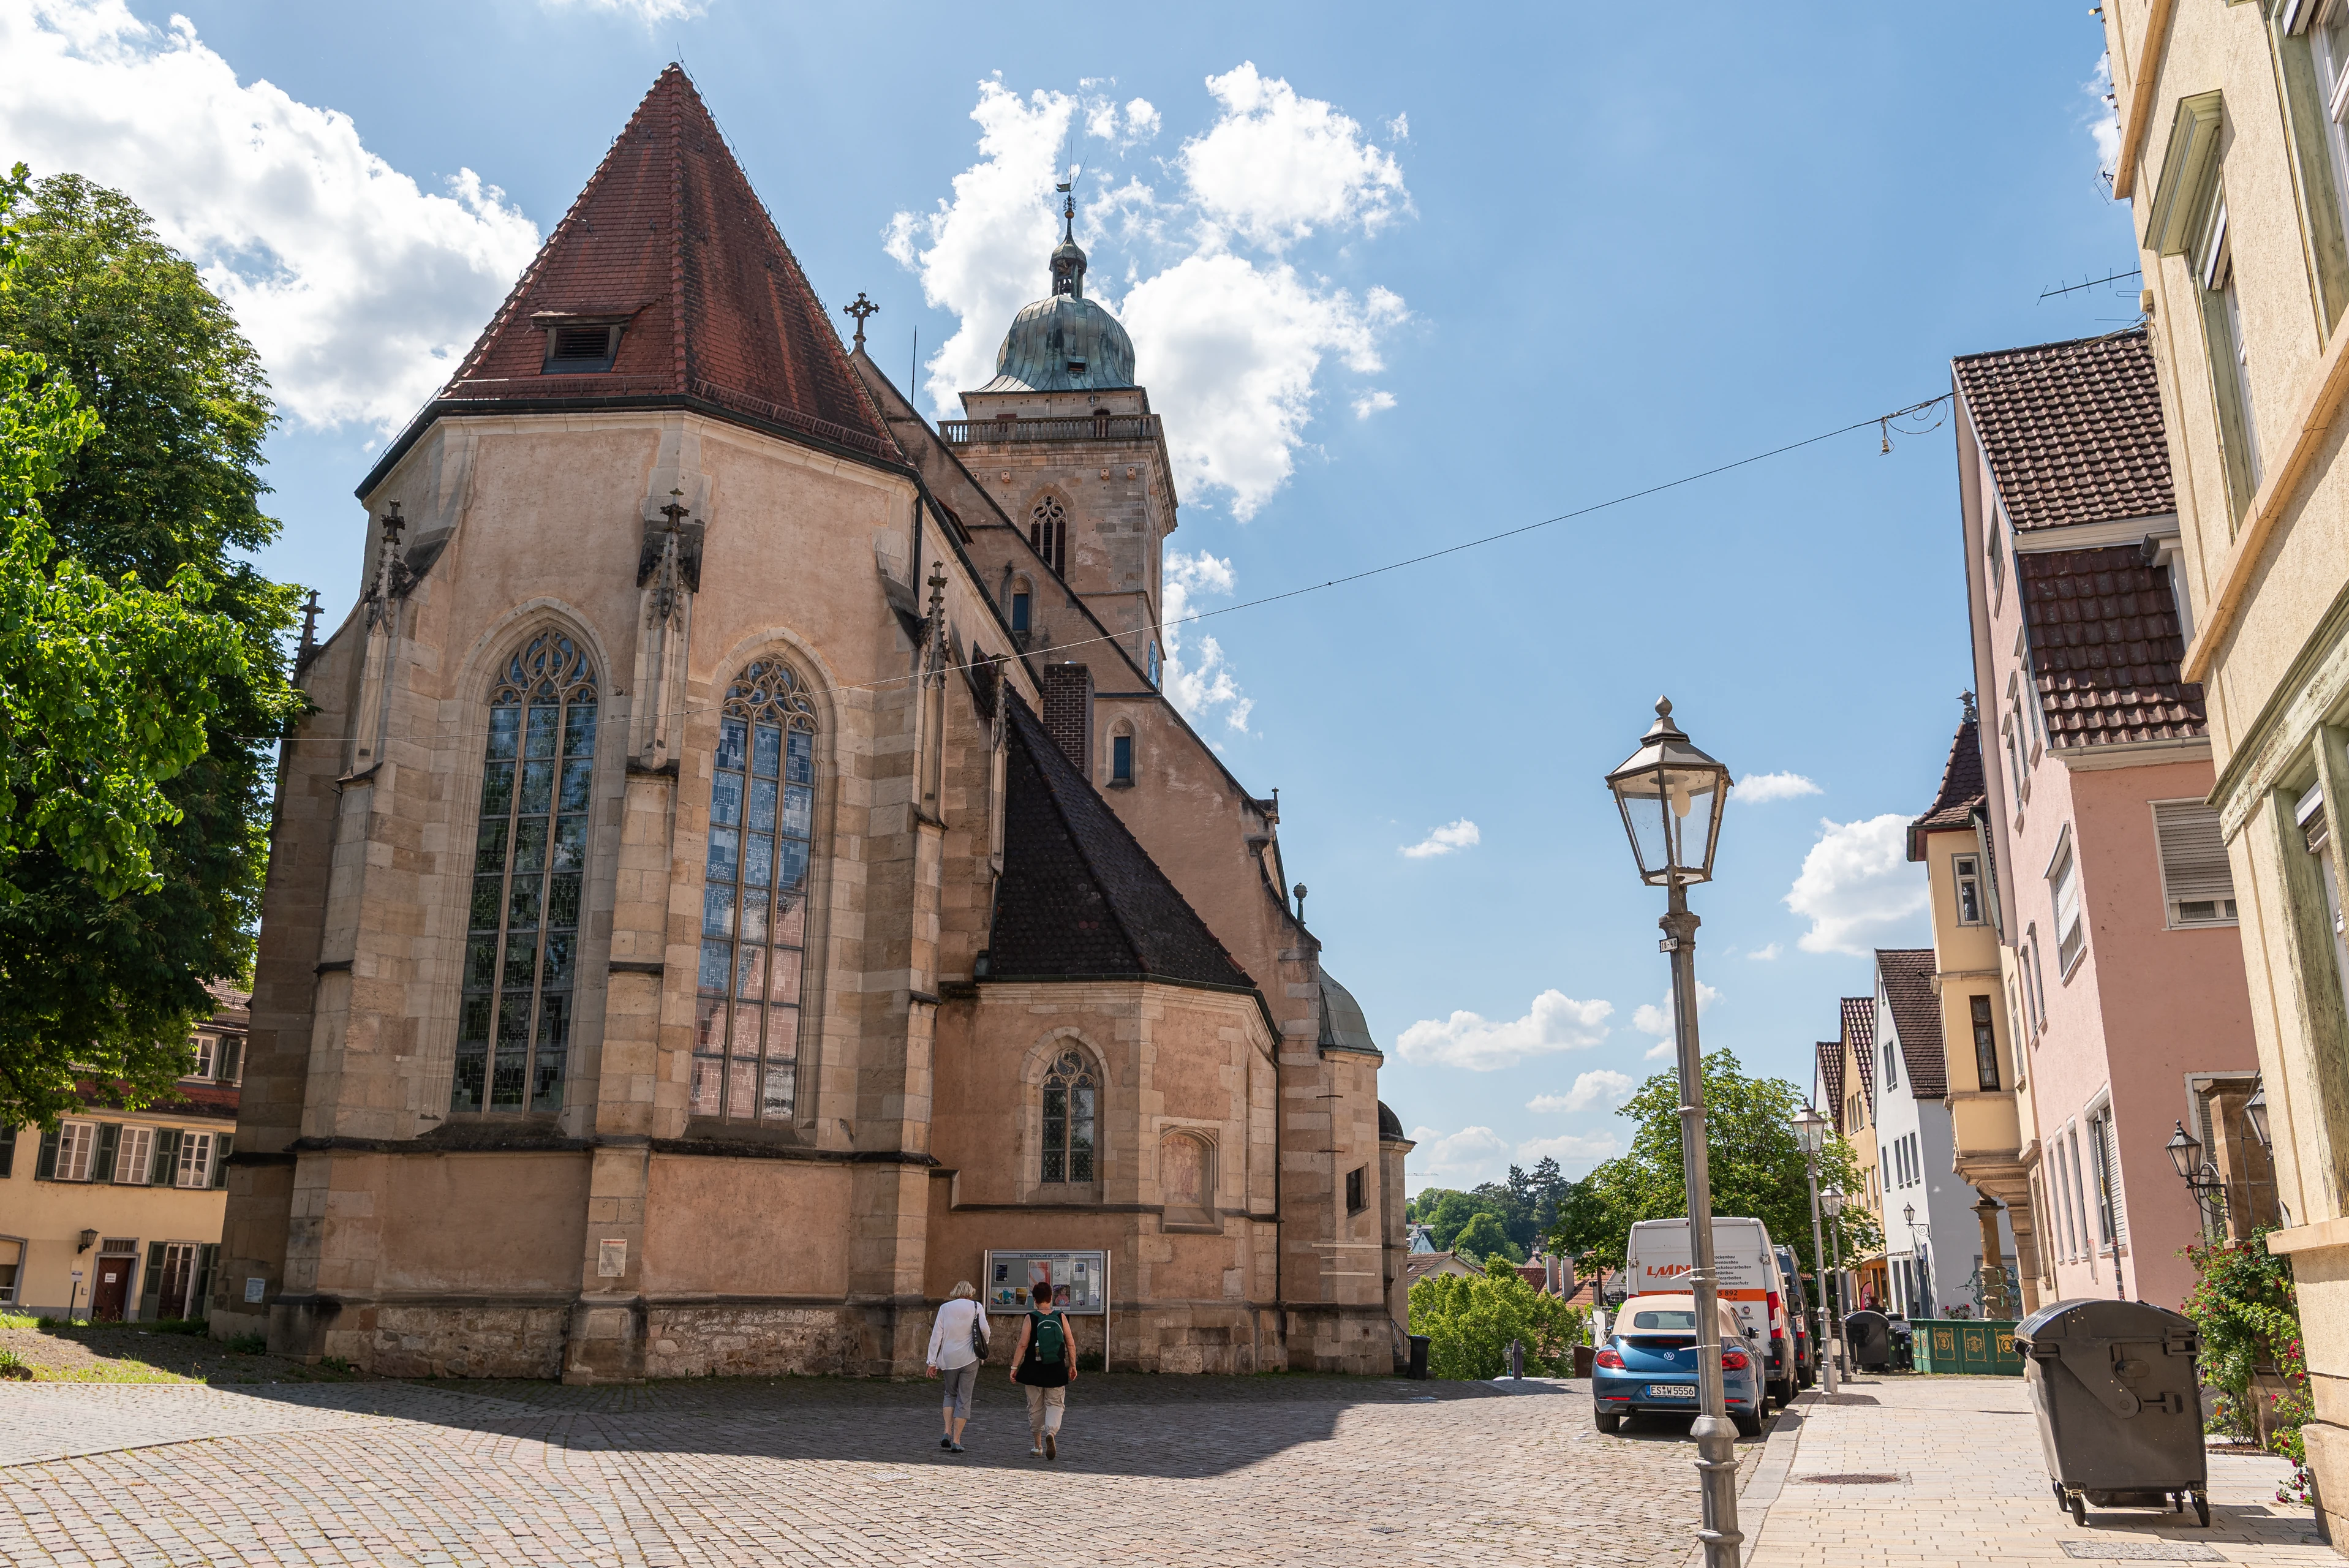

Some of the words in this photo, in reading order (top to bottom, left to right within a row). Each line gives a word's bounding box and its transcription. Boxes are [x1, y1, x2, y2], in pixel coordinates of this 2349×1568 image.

[1646, 1264, 1691, 1278] LMN
[1651, 1386, 1662, 1395] ES
[1673, 1387, 1694, 1395] 5556
